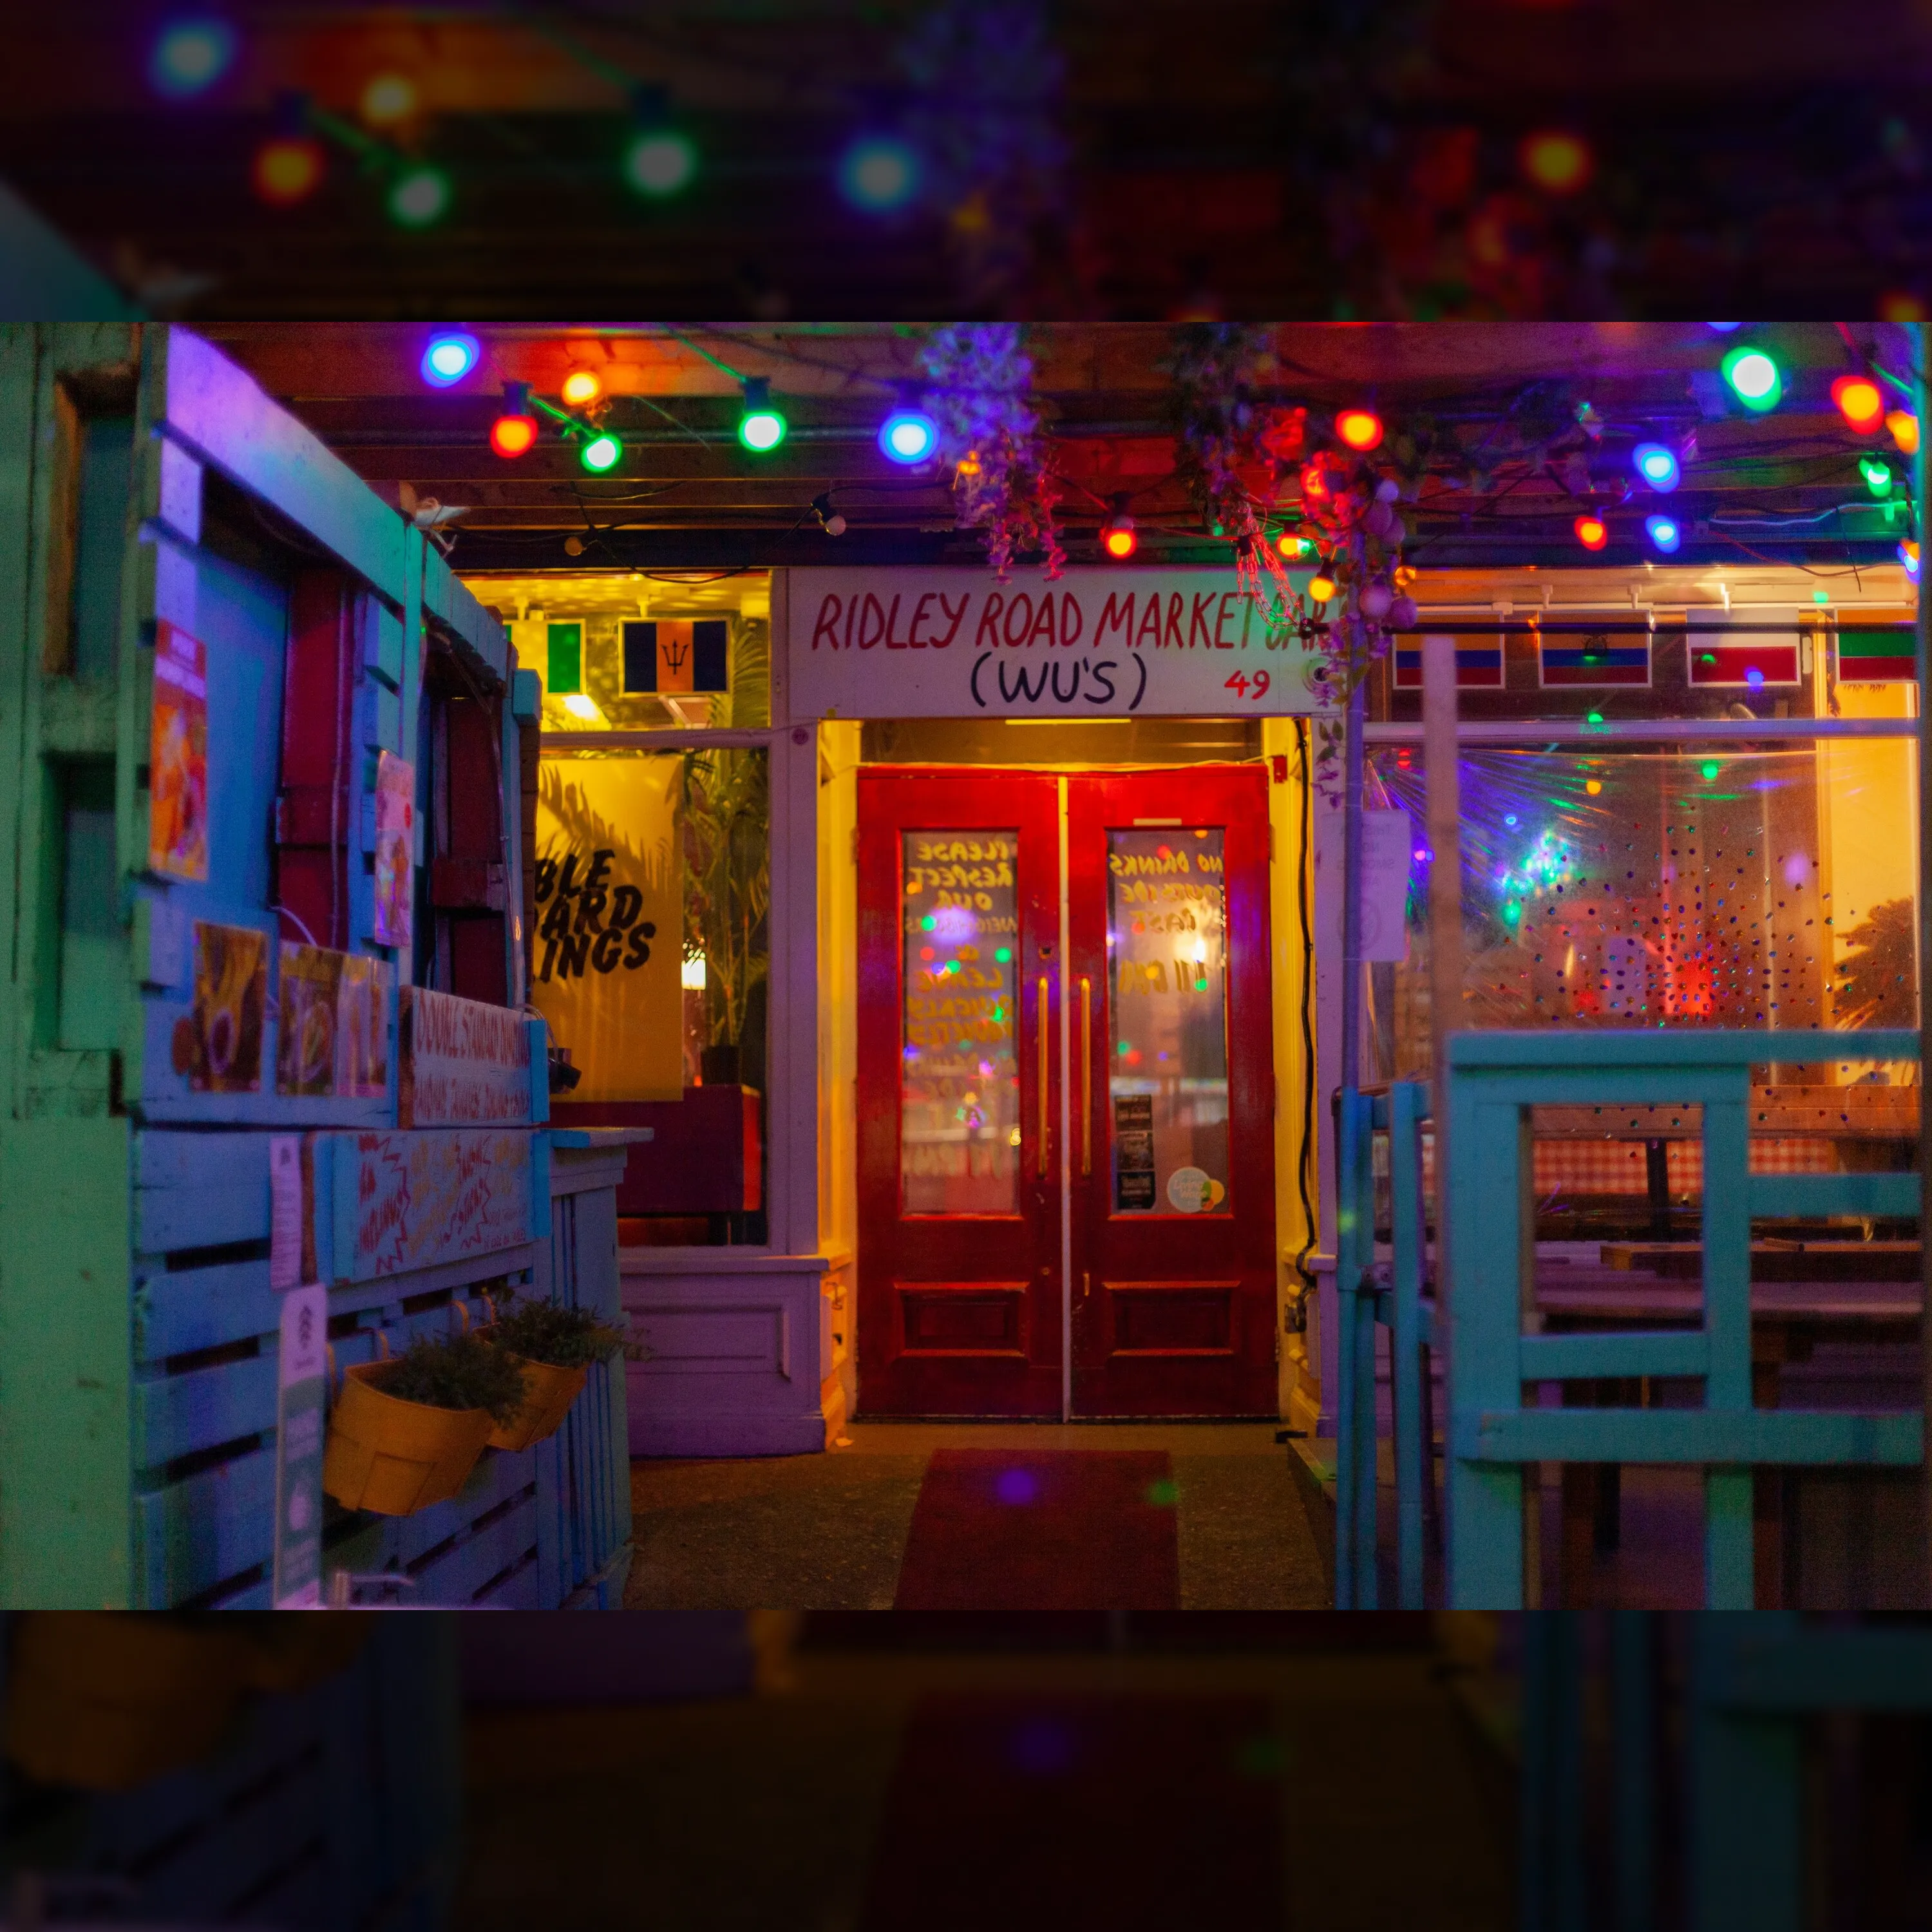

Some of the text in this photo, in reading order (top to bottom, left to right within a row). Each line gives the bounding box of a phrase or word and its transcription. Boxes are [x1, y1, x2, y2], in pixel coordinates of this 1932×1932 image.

[812, 593, 970, 650] RIDLEY
[976, 593, 1083, 649] ROAD
[1094, 592, 1255, 650] MARKET
[971, 652, 1148, 710] (WU'S)
[1224, 670, 1270, 699] 49
[535, 885, 643, 940] ARD
